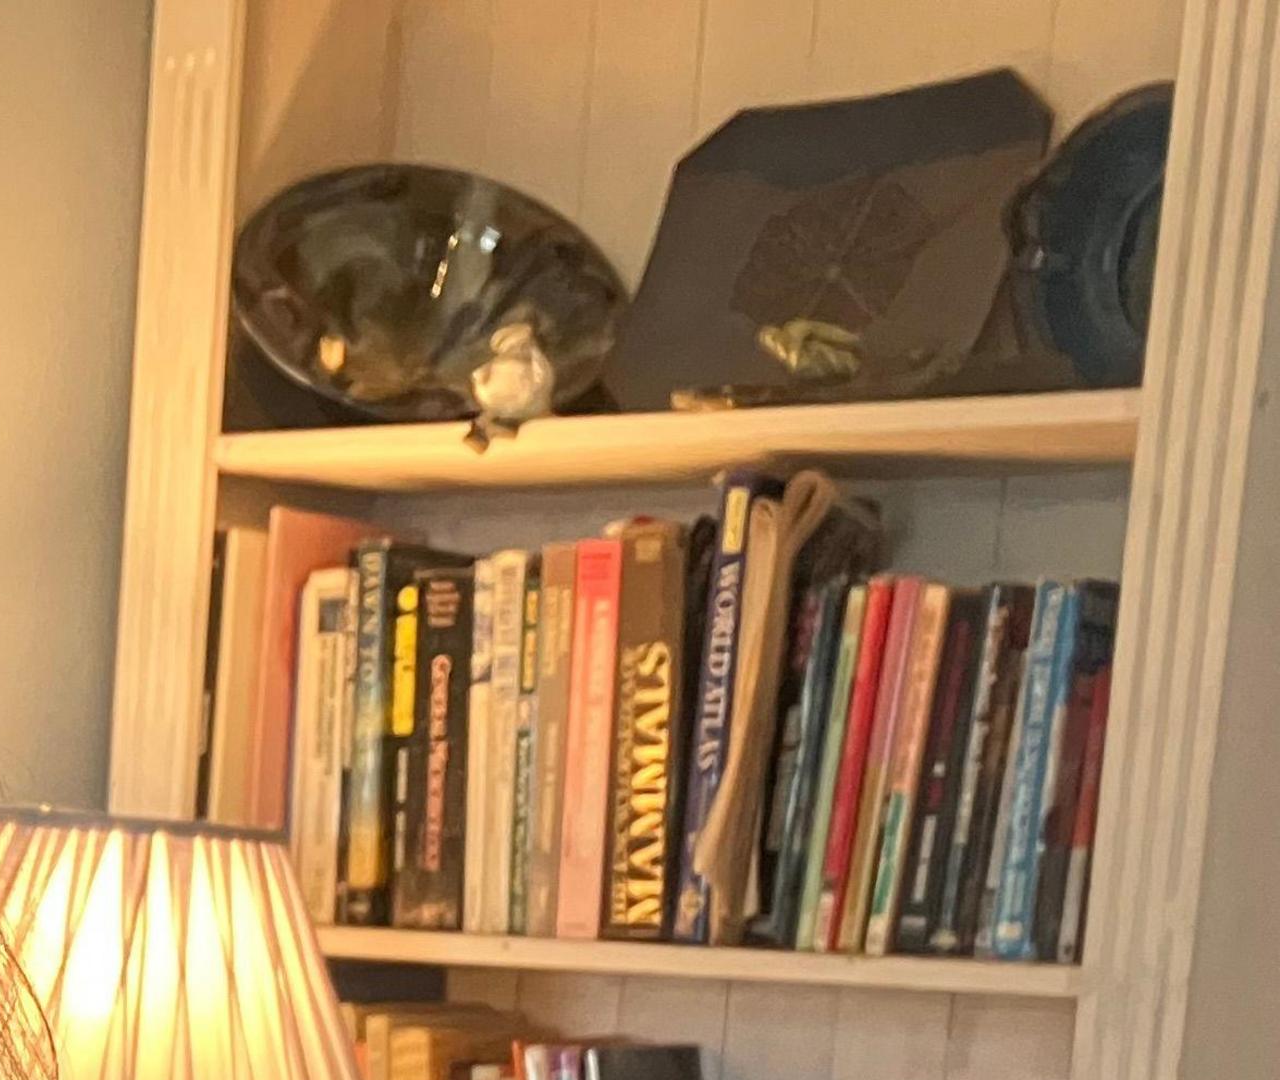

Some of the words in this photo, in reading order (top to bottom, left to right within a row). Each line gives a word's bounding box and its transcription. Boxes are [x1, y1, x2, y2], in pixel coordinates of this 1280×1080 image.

[706, 562, 739, 679] WORLD
[625, 641, 671, 926] MAMMALS
[697, 682, 727, 771] ATLAS
